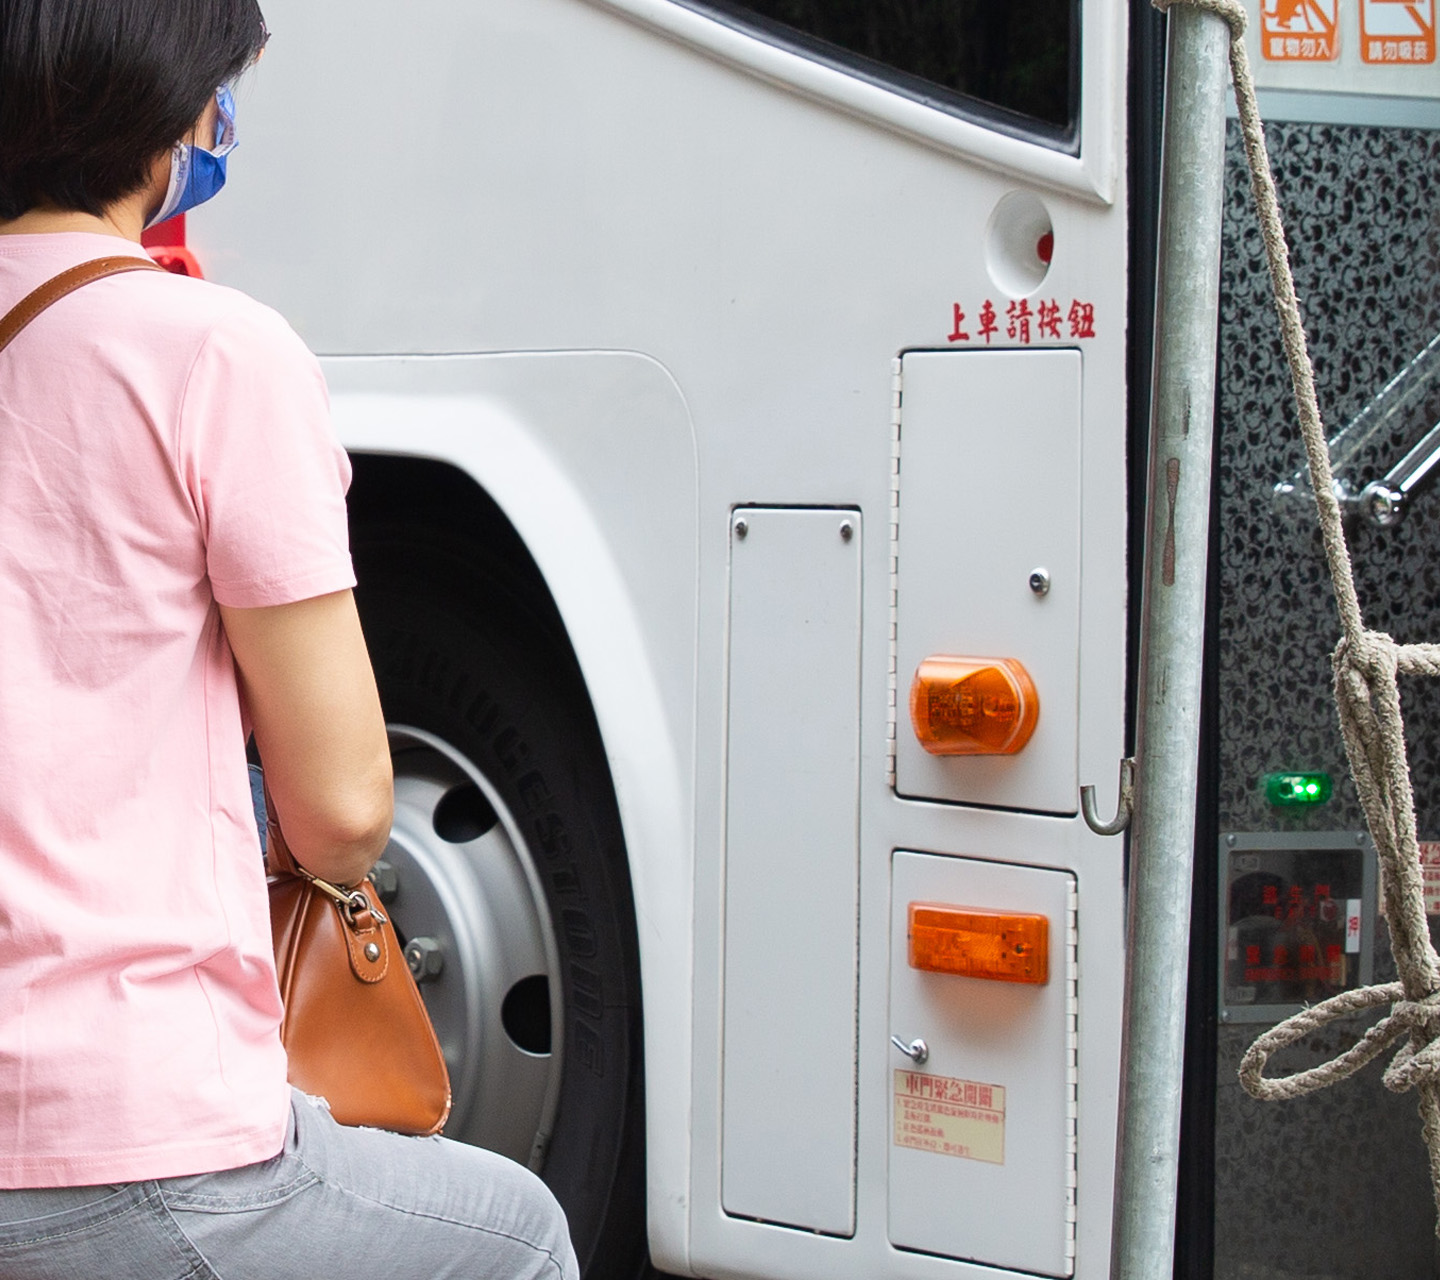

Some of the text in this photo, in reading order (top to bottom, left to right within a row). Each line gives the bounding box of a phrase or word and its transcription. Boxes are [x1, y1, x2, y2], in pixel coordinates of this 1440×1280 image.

[947, 298, 1096, 345] 上車請按鈕
